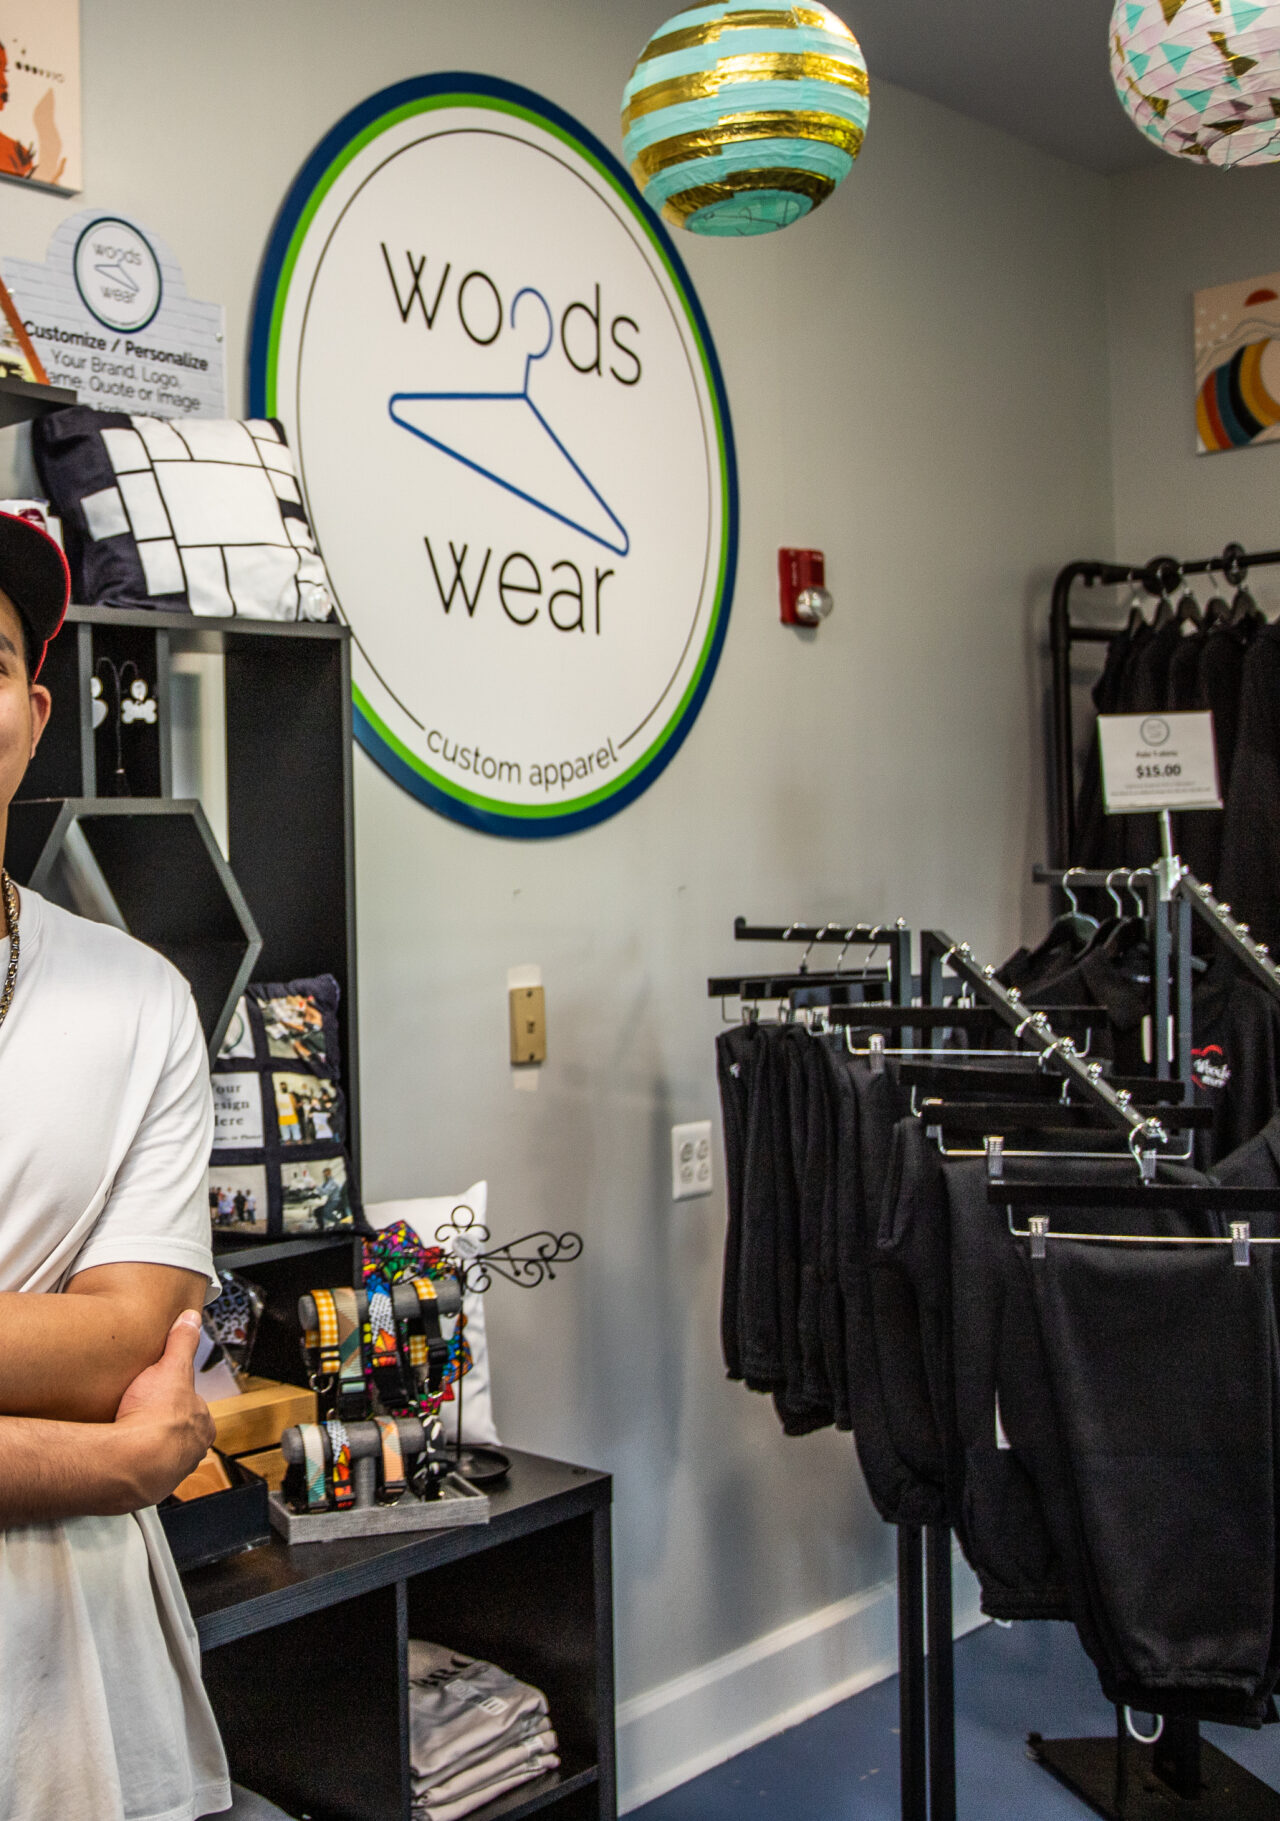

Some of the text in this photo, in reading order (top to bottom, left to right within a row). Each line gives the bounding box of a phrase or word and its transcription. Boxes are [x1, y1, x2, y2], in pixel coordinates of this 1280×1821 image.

[25, 320, 106, 352] Customize
[125, 340, 208, 372] Personalize
[51, 349, 87, 368] Your
[89, 376, 134, 398] Quote
[139, 388, 153, 401] or
[157, 389, 201, 411] Image
[424, 535, 615, 636] wear
[426, 730, 618, 792] custom apparel
[1135, 763, 1182, 780] $15.00
[213, 1099, 249, 1112] esign
